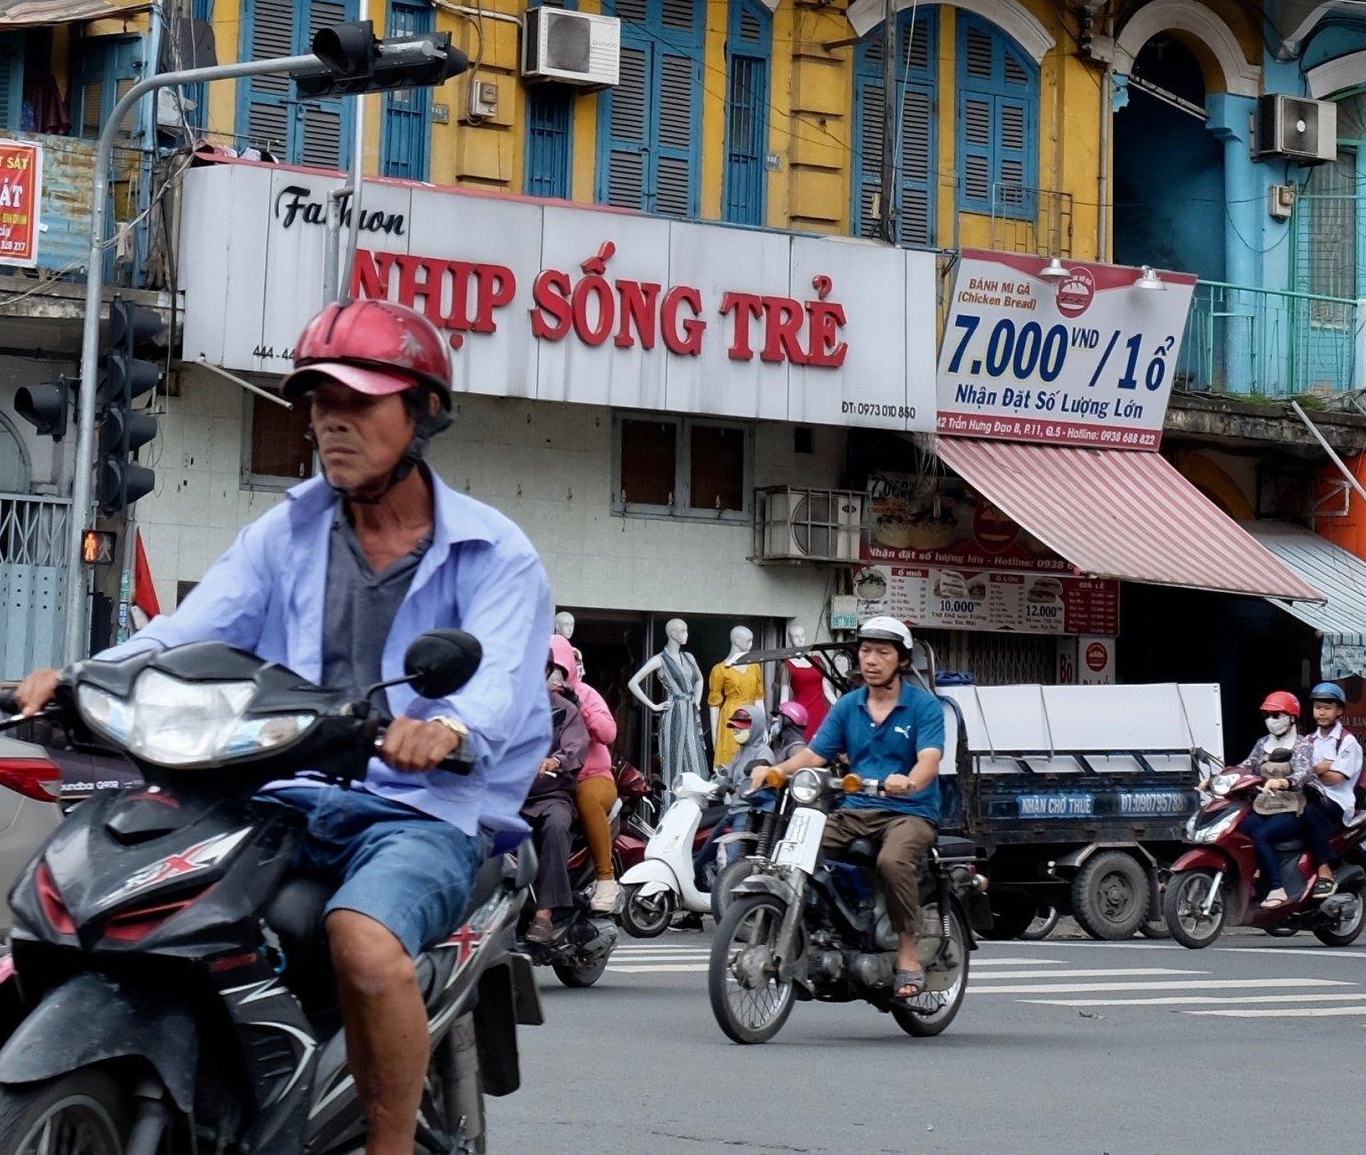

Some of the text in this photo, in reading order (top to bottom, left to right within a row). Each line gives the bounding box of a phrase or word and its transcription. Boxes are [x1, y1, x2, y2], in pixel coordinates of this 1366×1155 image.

[969, 277, 998, 294] BÁNH
[1017, 281, 1031, 295] GÀ
[348, 240, 849, 368] NHỊP SỐNG TRẺ
[957, 291, 1037, 310] (Chicken Bread)
[948, 314, 1069, 383] 7.000
[955, 384, 1144, 420] Nhận Đặt Số Lượng Lớn
[949, 415, 967, 431] Trần
[940, 600, 974, 613] 10.000
[1026, 605, 1057, 618] 12.000
